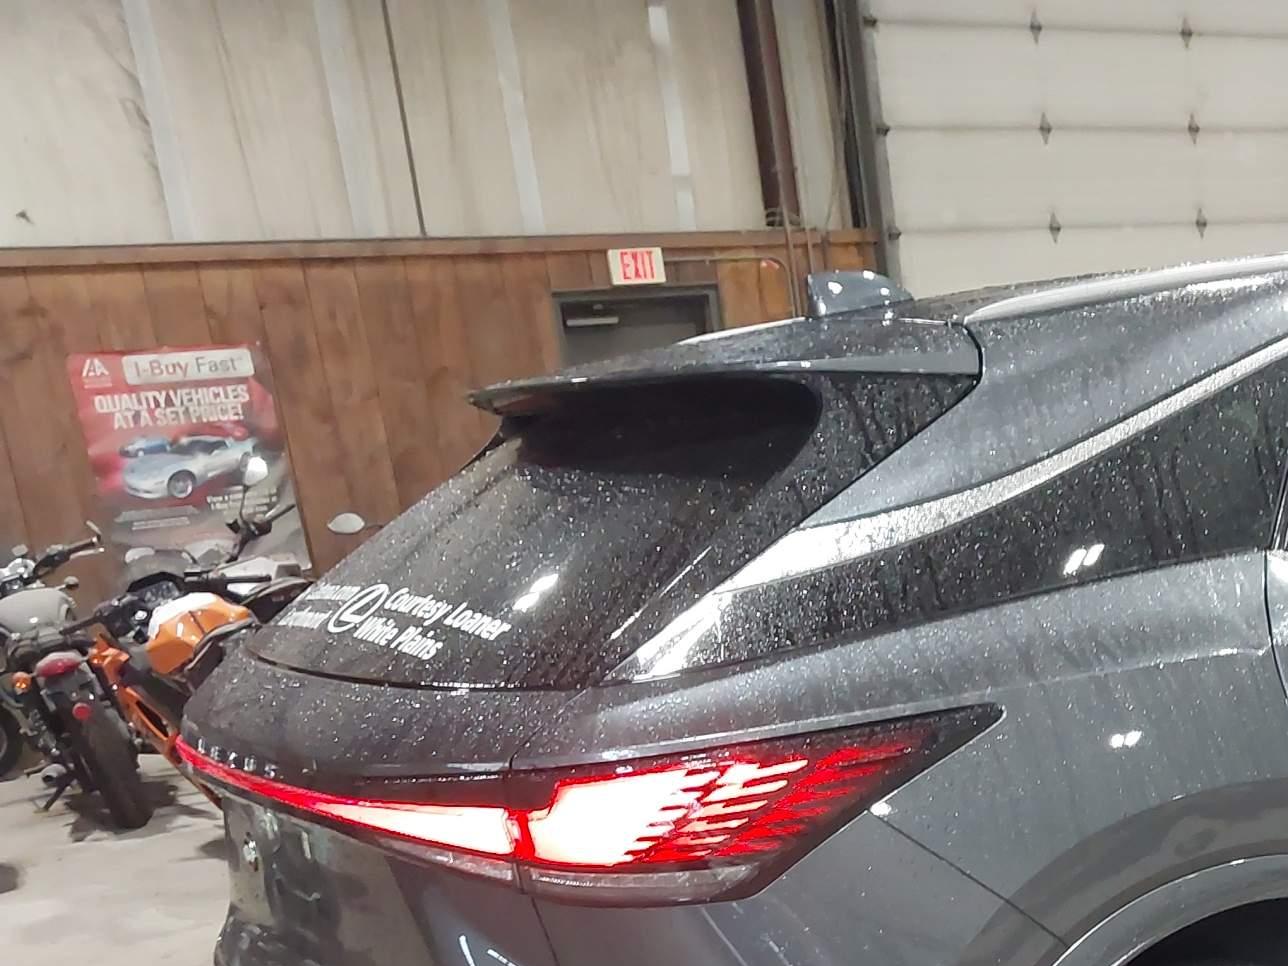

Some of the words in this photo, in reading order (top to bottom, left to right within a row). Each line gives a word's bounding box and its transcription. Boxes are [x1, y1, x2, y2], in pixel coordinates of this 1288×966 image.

[620, 251, 655, 280] EXIT
[134, 357, 189, 378] I-Buy
[94, 390, 168, 414] QUALITY
[169, 384, 249, 408] VEHICLES
[113, 411, 138, 430] AT
[139, 411, 154, 428] A
[155, 407, 185, 426] SET
[188, 403, 244, 423] PRICE!
[384, 588, 452, 627] Courtesy
[443, 602, 511, 641] Loaner
[353, 615, 400, 646] White
[390, 626, 443, 660] Plains
